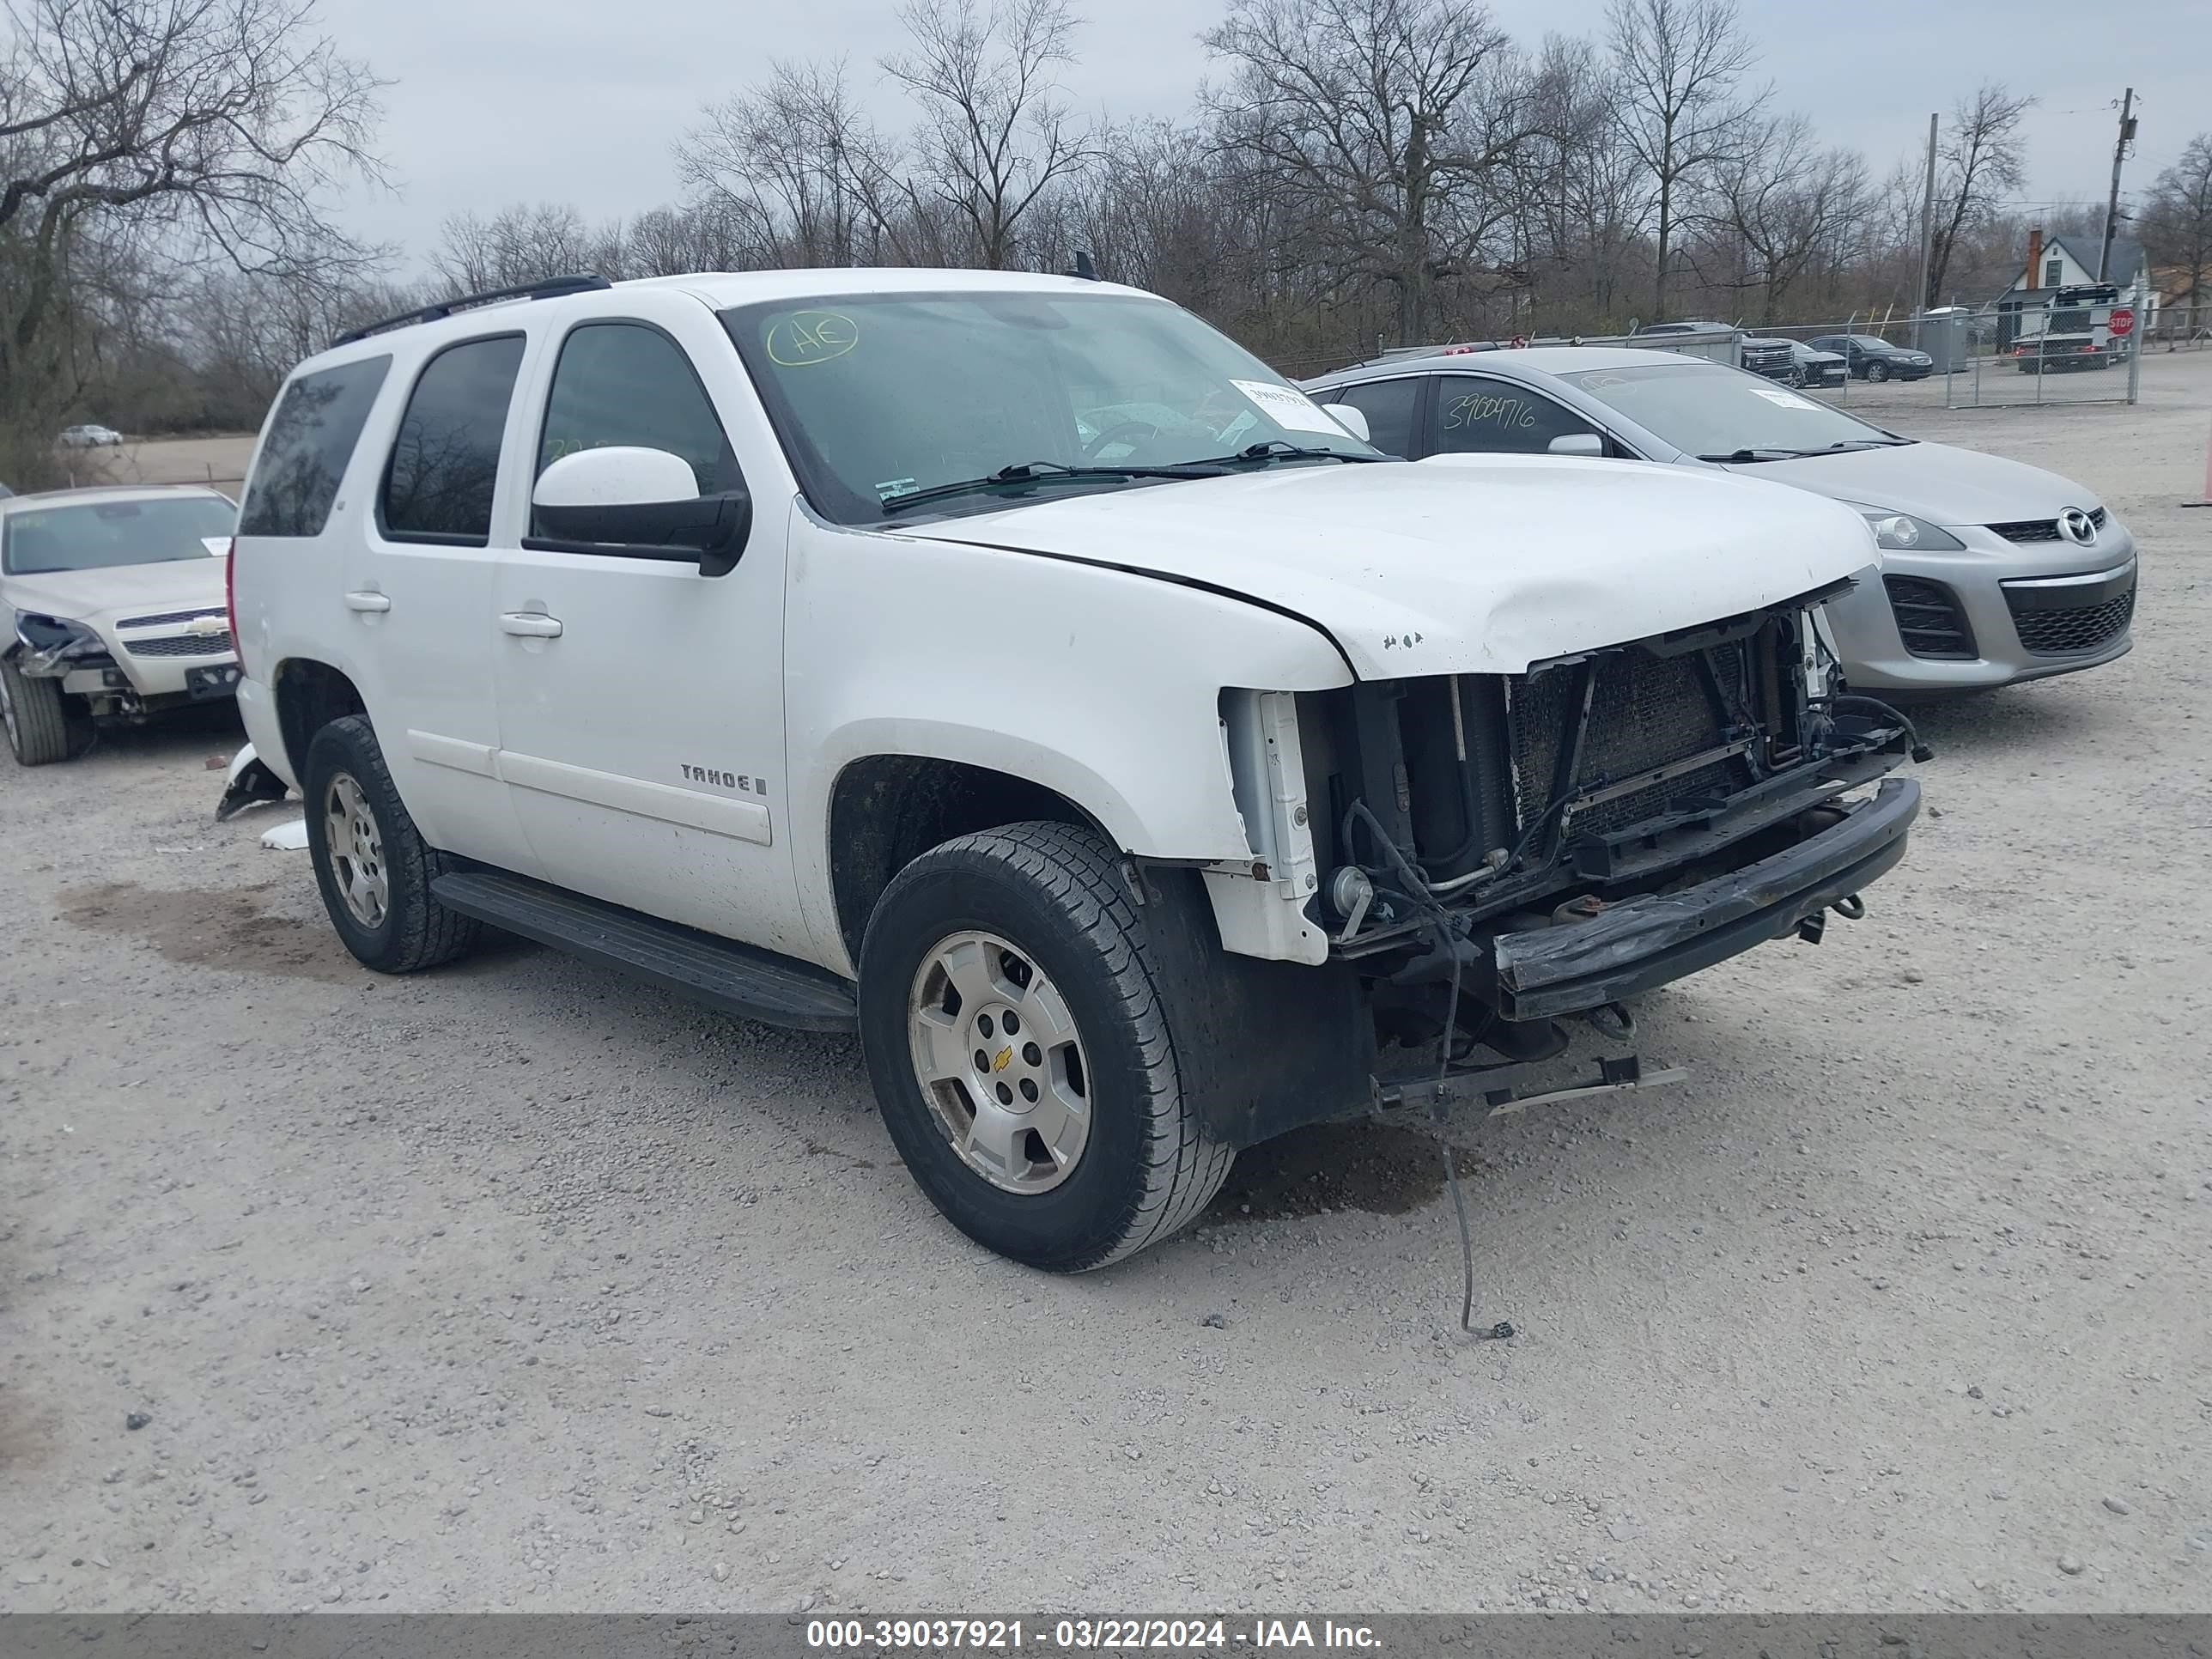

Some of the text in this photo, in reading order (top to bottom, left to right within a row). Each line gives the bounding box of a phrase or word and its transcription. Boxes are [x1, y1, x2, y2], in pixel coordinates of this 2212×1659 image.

[789, 319, 852, 355] AE
[2109, 317, 2134, 328] STOP
[1443, 392, 1535, 429] 39004716
[680, 763, 750, 791] TAHOE
